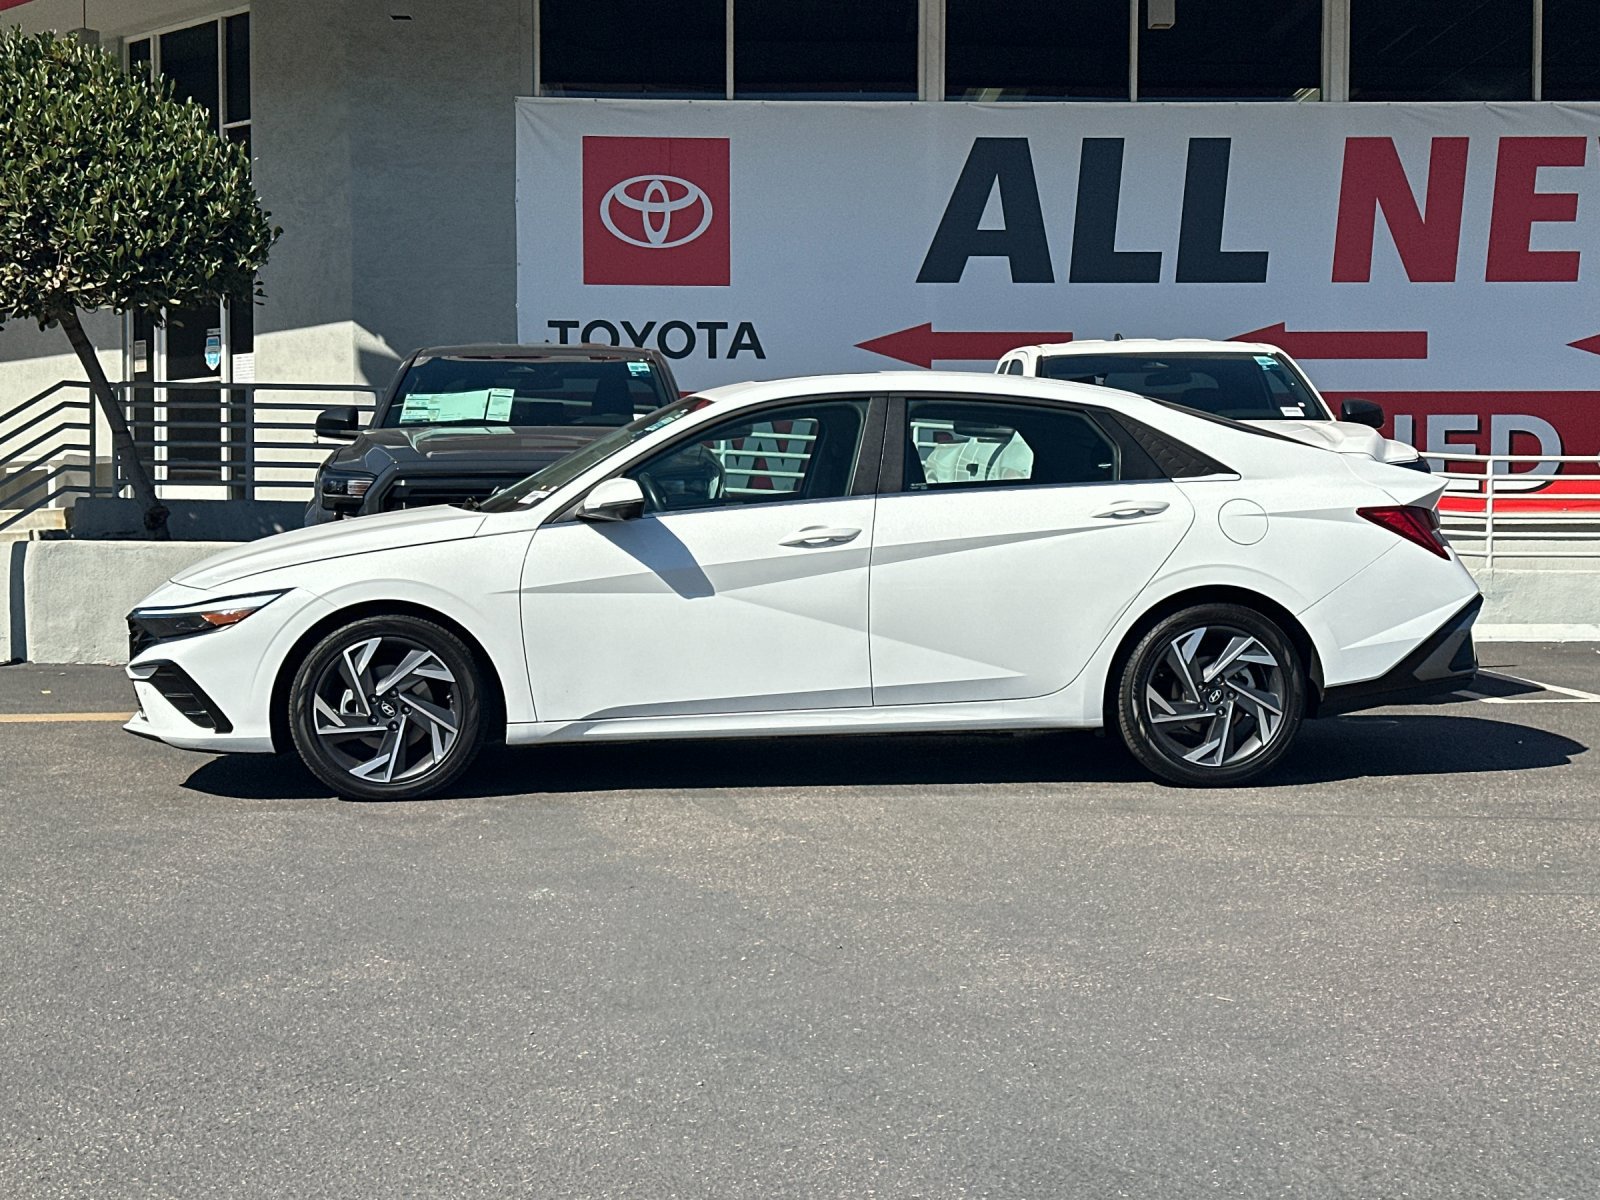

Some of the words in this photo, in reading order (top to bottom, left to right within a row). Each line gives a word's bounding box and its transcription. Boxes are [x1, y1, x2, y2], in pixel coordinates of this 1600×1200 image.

[915, 137, 1269, 283] ALL
[1331, 136, 1600, 283] NE
[547, 319, 767, 360] TOYOTA
